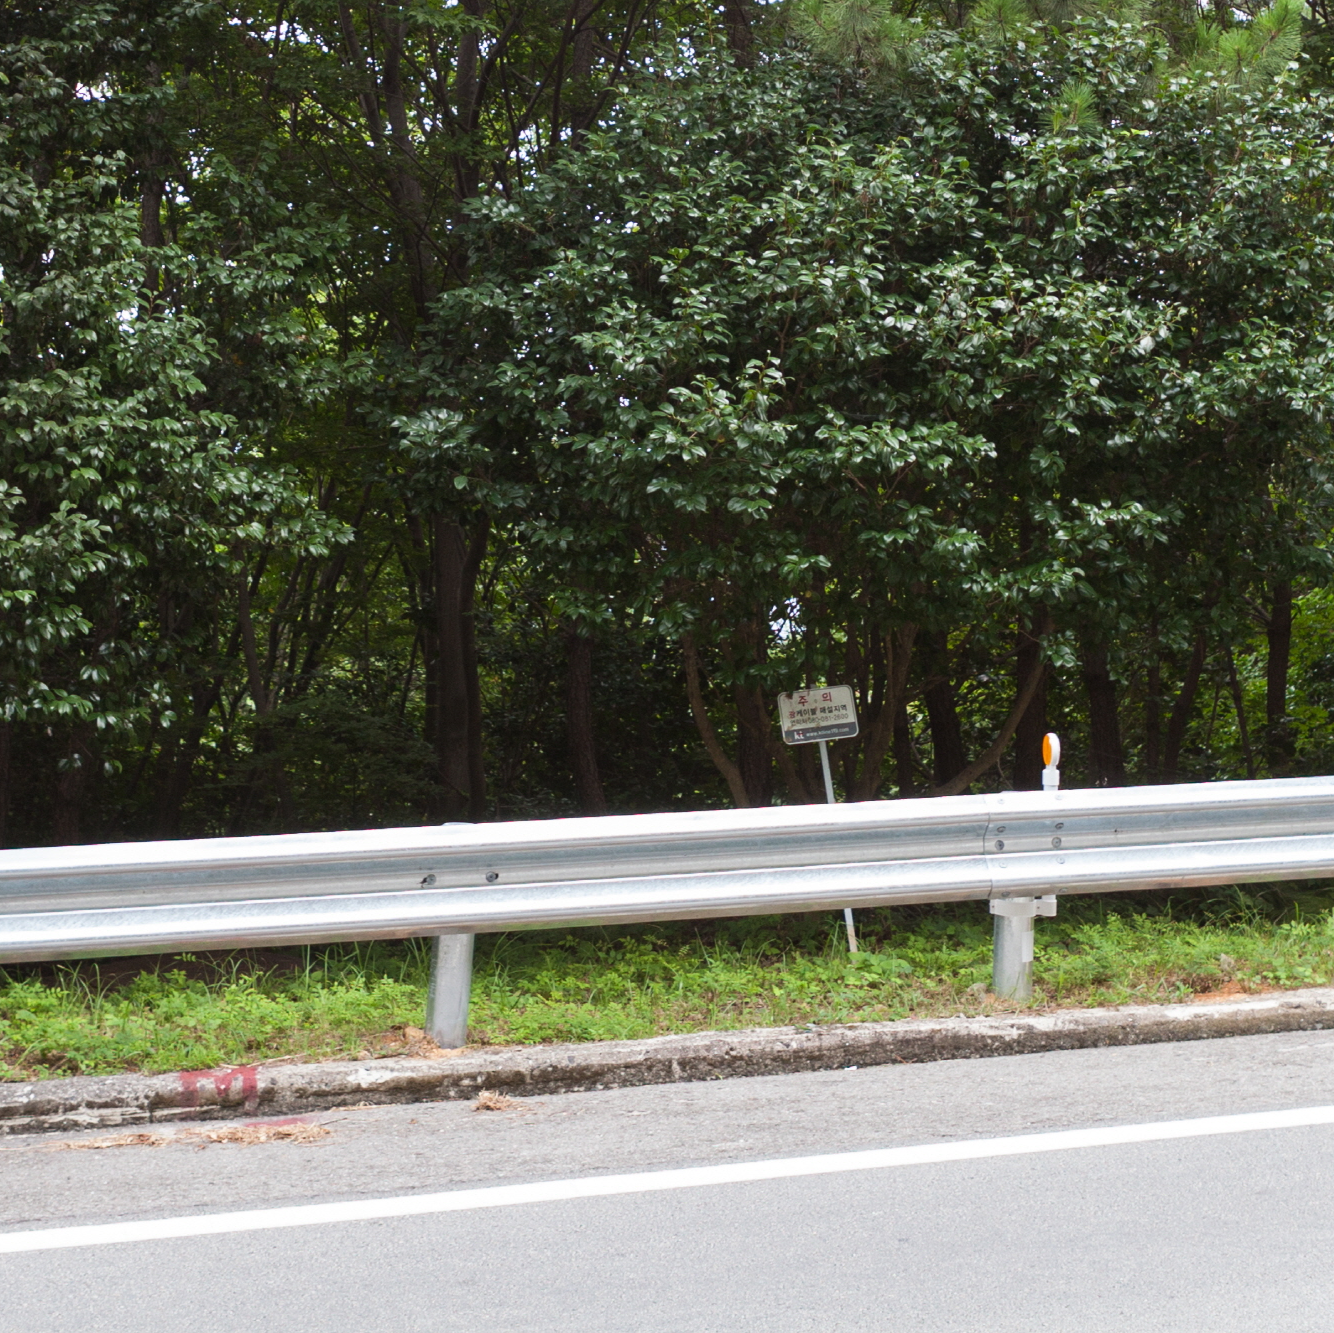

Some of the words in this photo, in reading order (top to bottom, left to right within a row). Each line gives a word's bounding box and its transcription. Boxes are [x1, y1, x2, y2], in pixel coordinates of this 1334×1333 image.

[789, 707, 817, 718] 광케이블
[819, 704, 847, 714] 매설지역
[794, 730, 805, 740] kt
